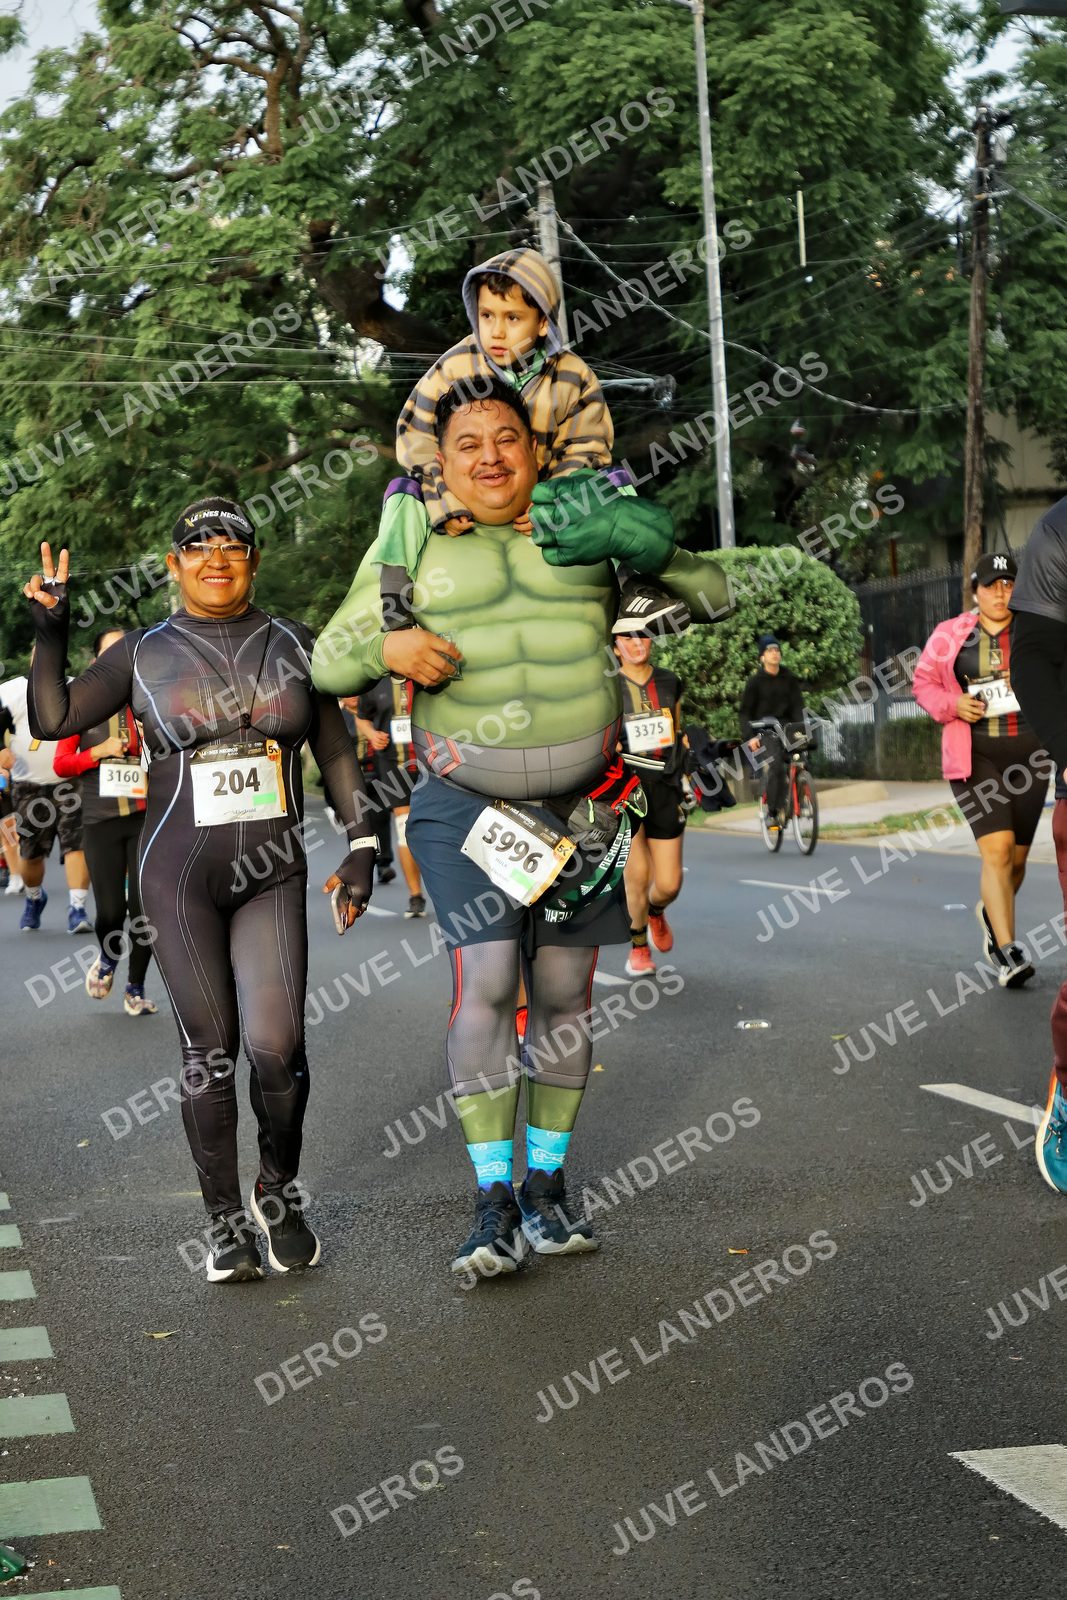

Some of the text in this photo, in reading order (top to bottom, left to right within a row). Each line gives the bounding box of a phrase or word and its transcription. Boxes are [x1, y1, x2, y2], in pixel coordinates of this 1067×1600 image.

[985, 685, 1012, 701] 912
[634, 722, 664, 737] 3375
[107, 769, 139, 783] 3160
[212, 767, 260, 796] 204
[482, 821, 543, 873] 5996
[599, 832, 624, 870] MEXICO
[615, 829, 632, 868] MEXICO
